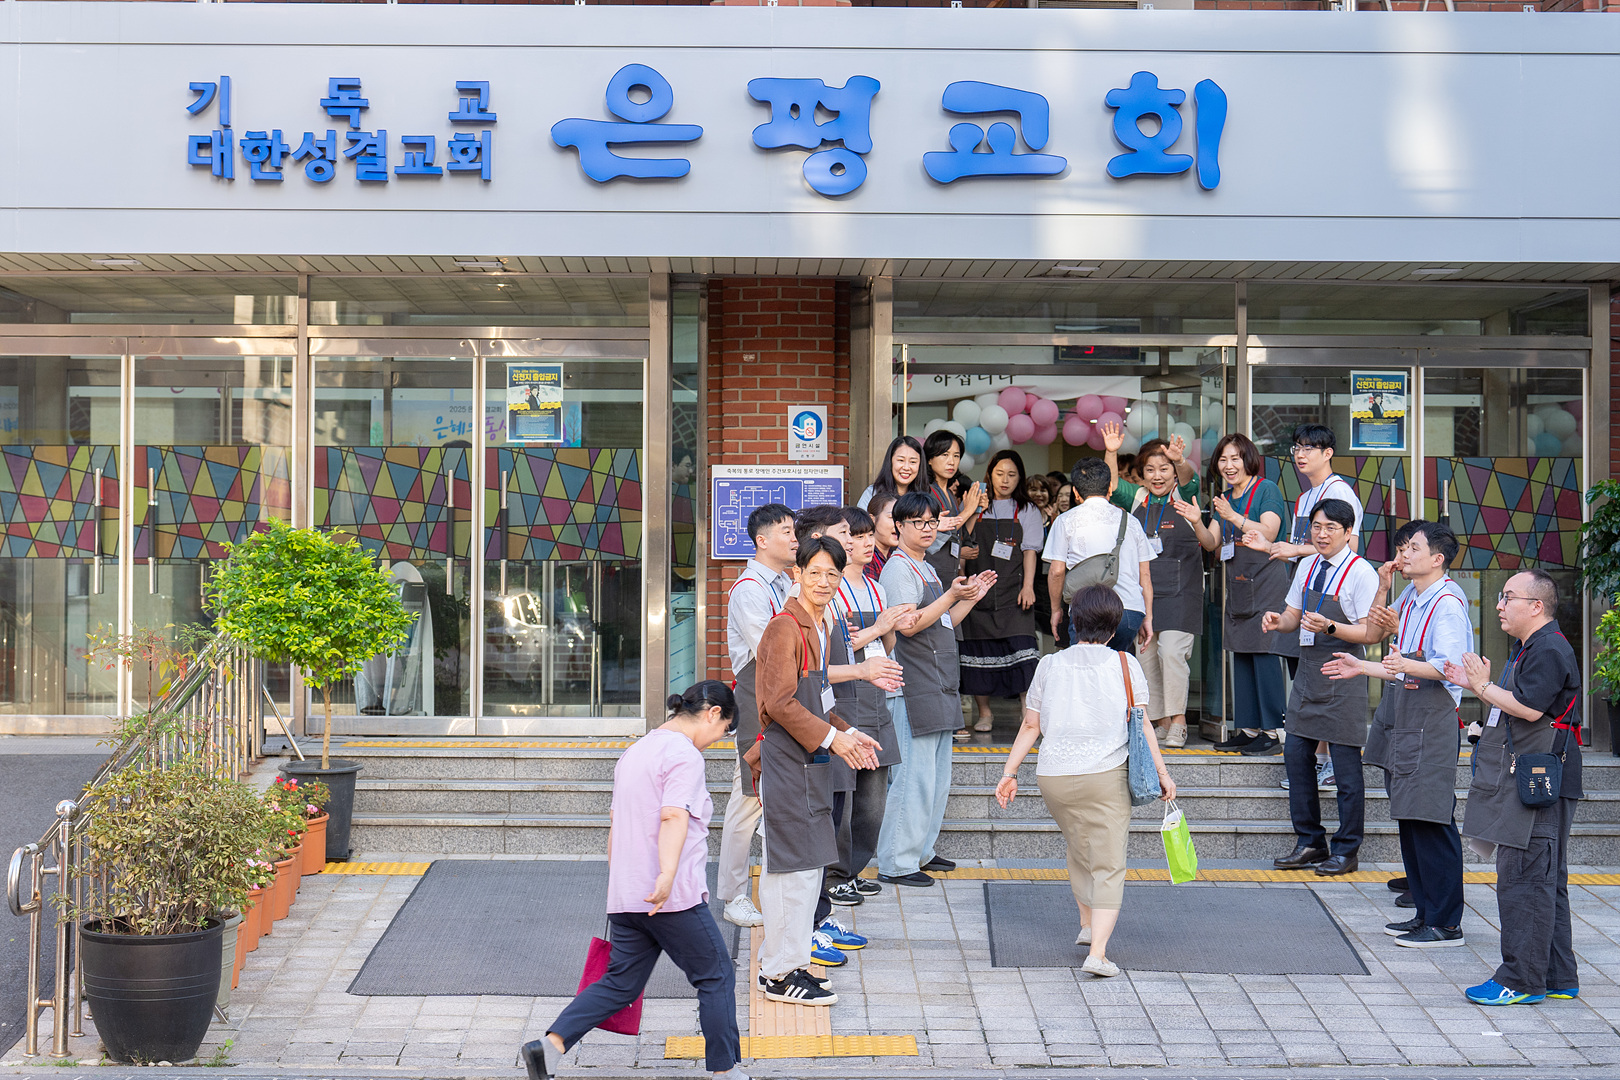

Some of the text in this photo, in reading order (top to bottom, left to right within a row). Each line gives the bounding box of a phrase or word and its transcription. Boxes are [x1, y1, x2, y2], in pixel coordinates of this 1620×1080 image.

[549, 62, 1229, 196] 은평교회
[186, 129, 492, 183] 대한성결교회
[449, 405, 467, 413] 2025
[1457, 571, 1471, 579] 10.1
